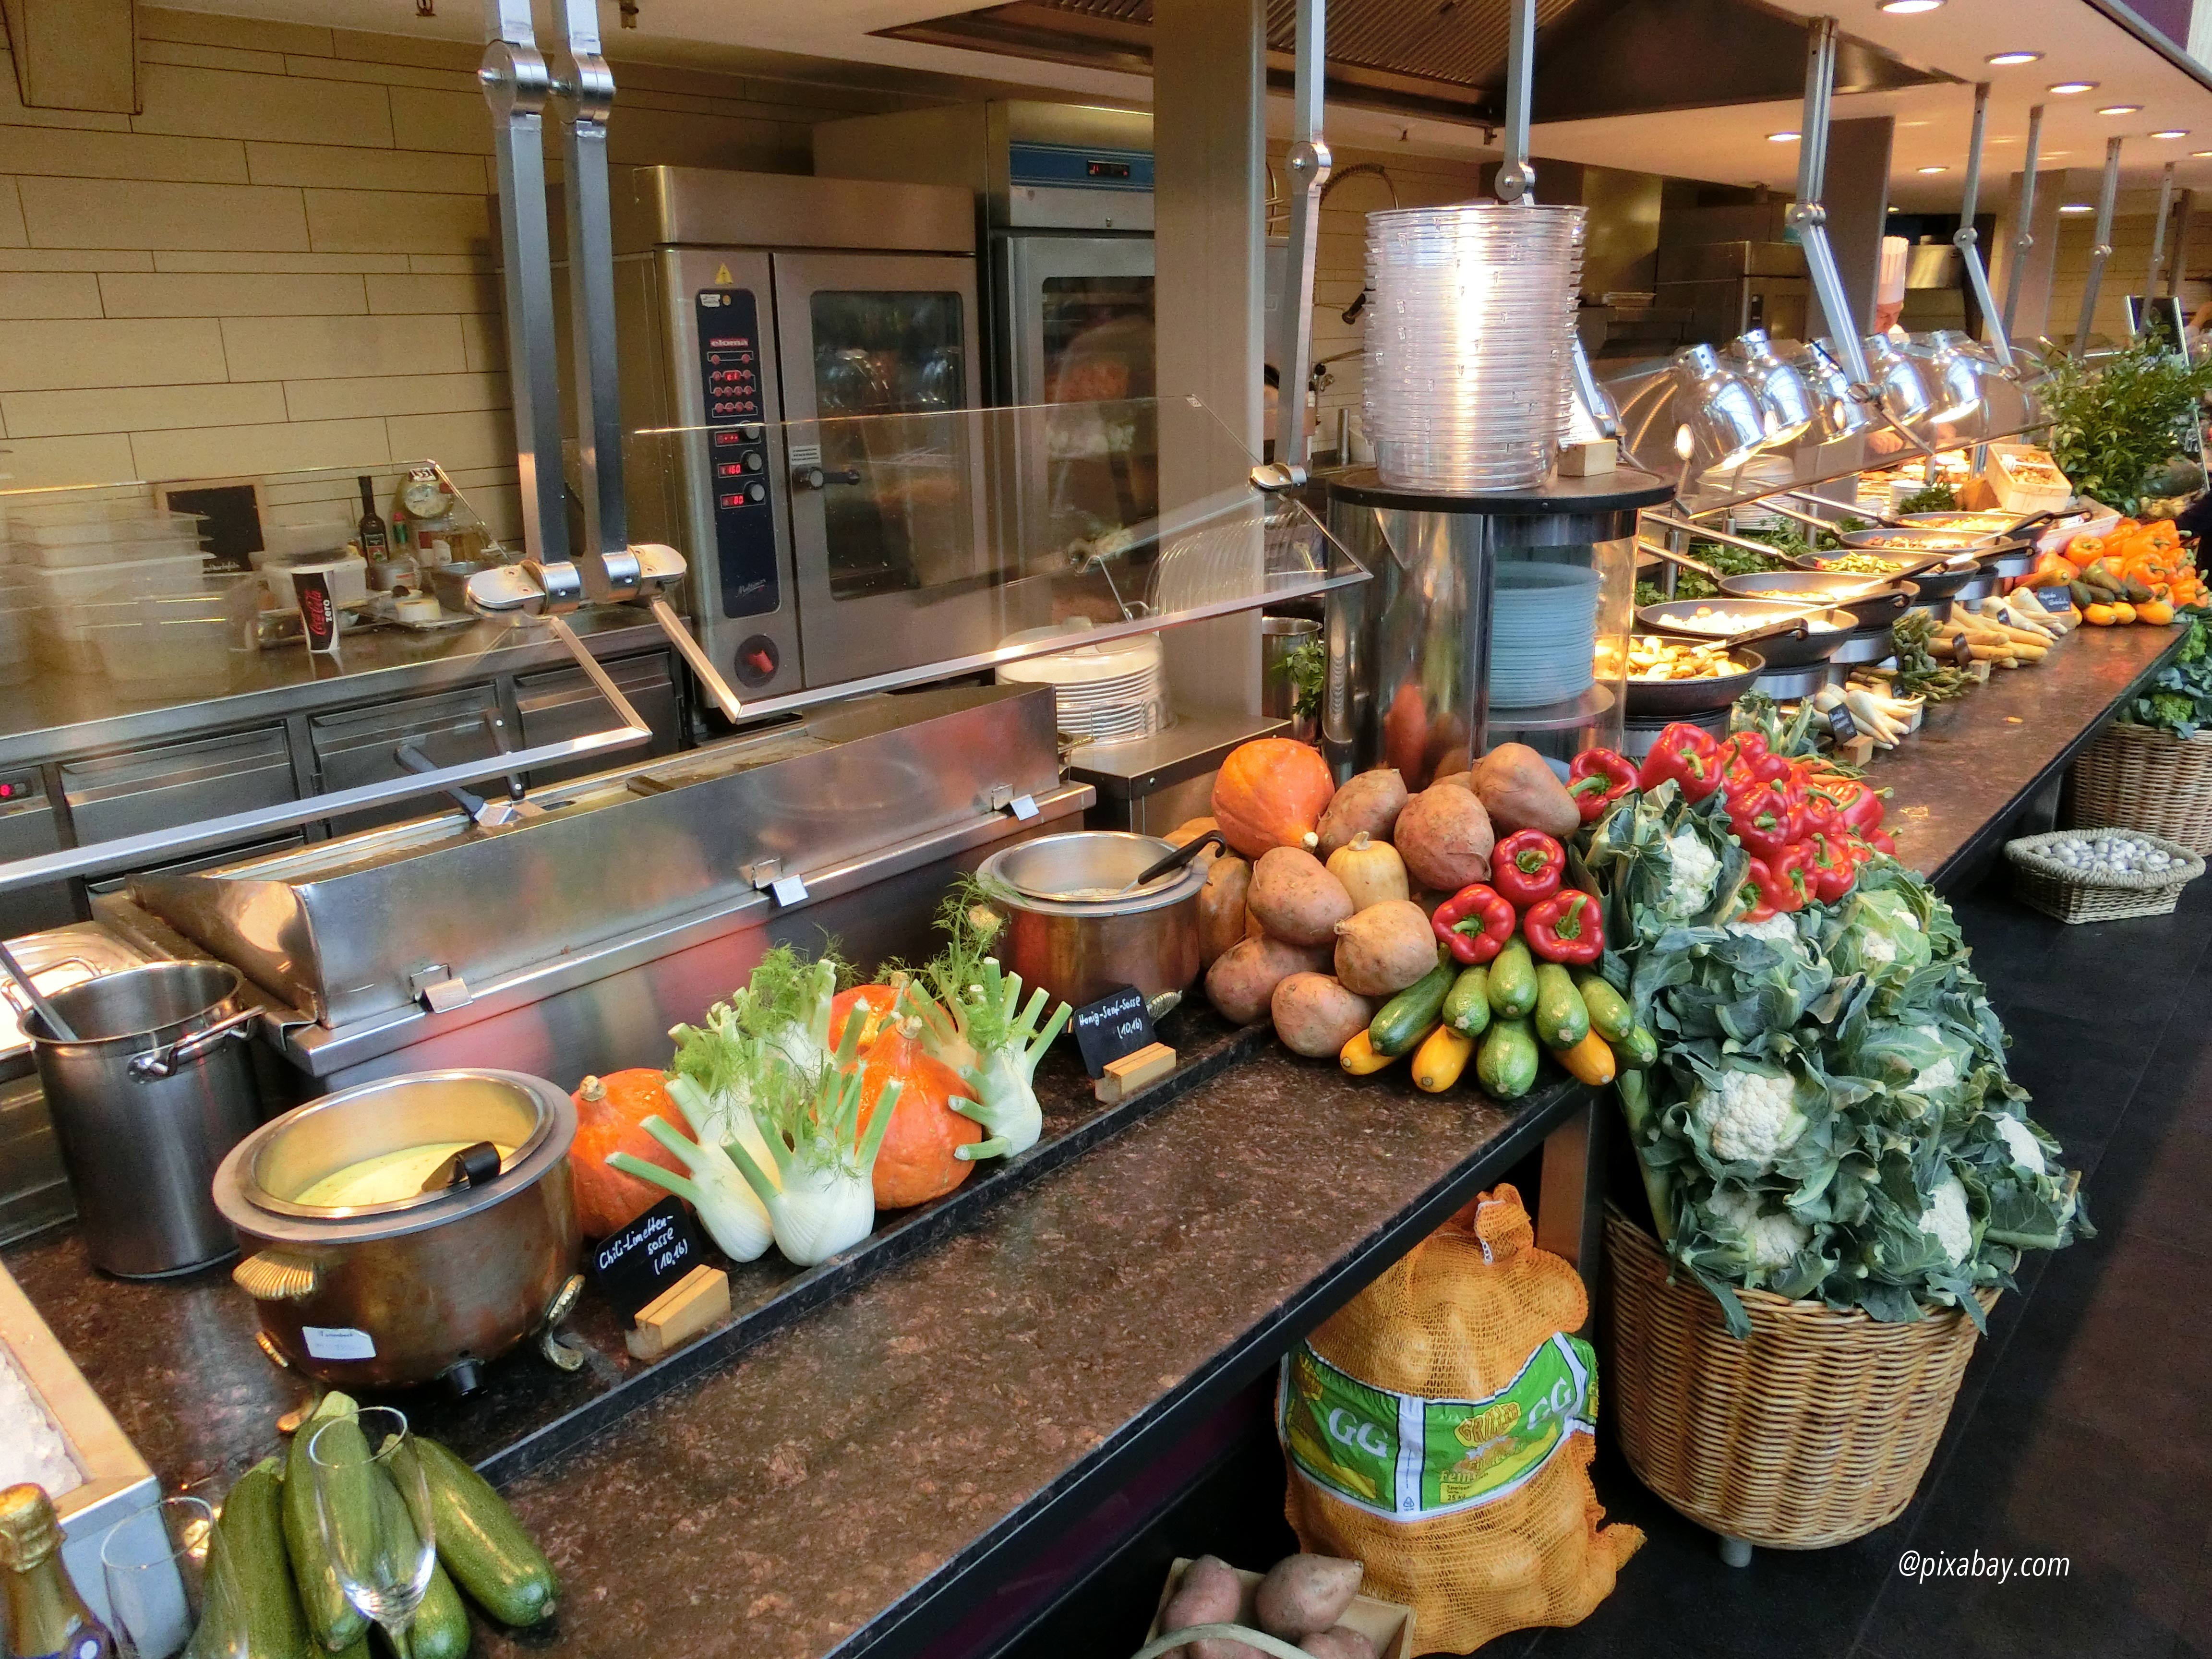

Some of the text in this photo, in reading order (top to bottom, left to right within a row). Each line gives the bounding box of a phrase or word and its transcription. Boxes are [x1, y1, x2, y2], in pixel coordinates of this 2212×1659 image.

[323, 599, 332, 623] zero
[1079, 996, 1141, 1027] Honig-Senf-Sosse
[600, 1215, 673, 1269] Chili-Limetten-
[1527, 1376, 1571, 1430] GG
[1329, 1407, 1389, 1458] GG
